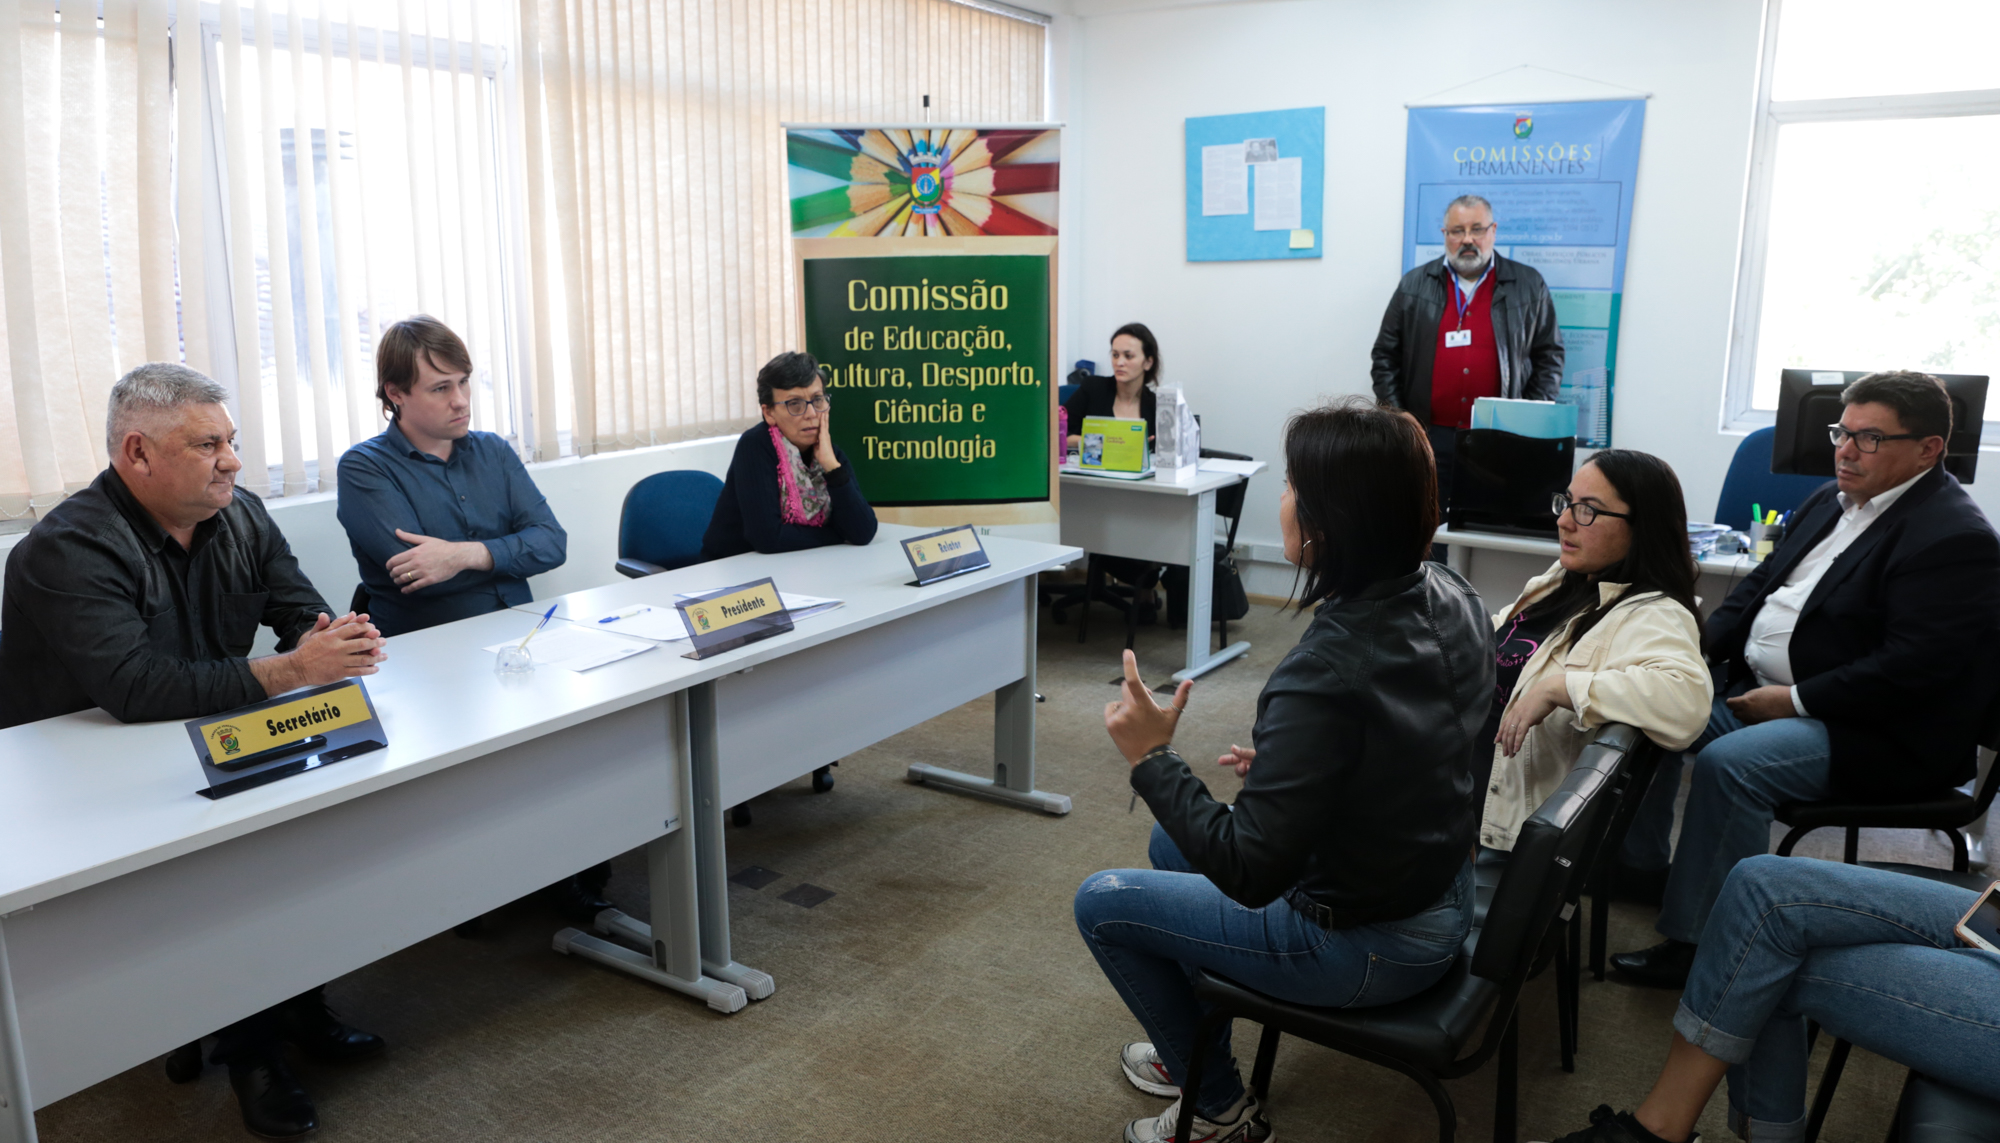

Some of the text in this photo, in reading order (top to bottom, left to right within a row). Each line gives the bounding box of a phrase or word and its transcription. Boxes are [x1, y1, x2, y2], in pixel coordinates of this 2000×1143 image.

[1453, 141, 1592, 163] COMISSÕES
[1458, 158, 1586, 176] PERMANENTES
[847, 278, 1009, 312] Comissão
[844, 325, 1013, 357] de Educação,
[818, 361, 1042, 392] Cultura, Desporto,
[874, 398, 986, 424] Ciência e
[862, 433, 996, 464] Tecnologia
[937, 540, 962, 554] Relator
[720, 596, 766, 619] Presidente
[265, 702, 341, 737] Secretário
